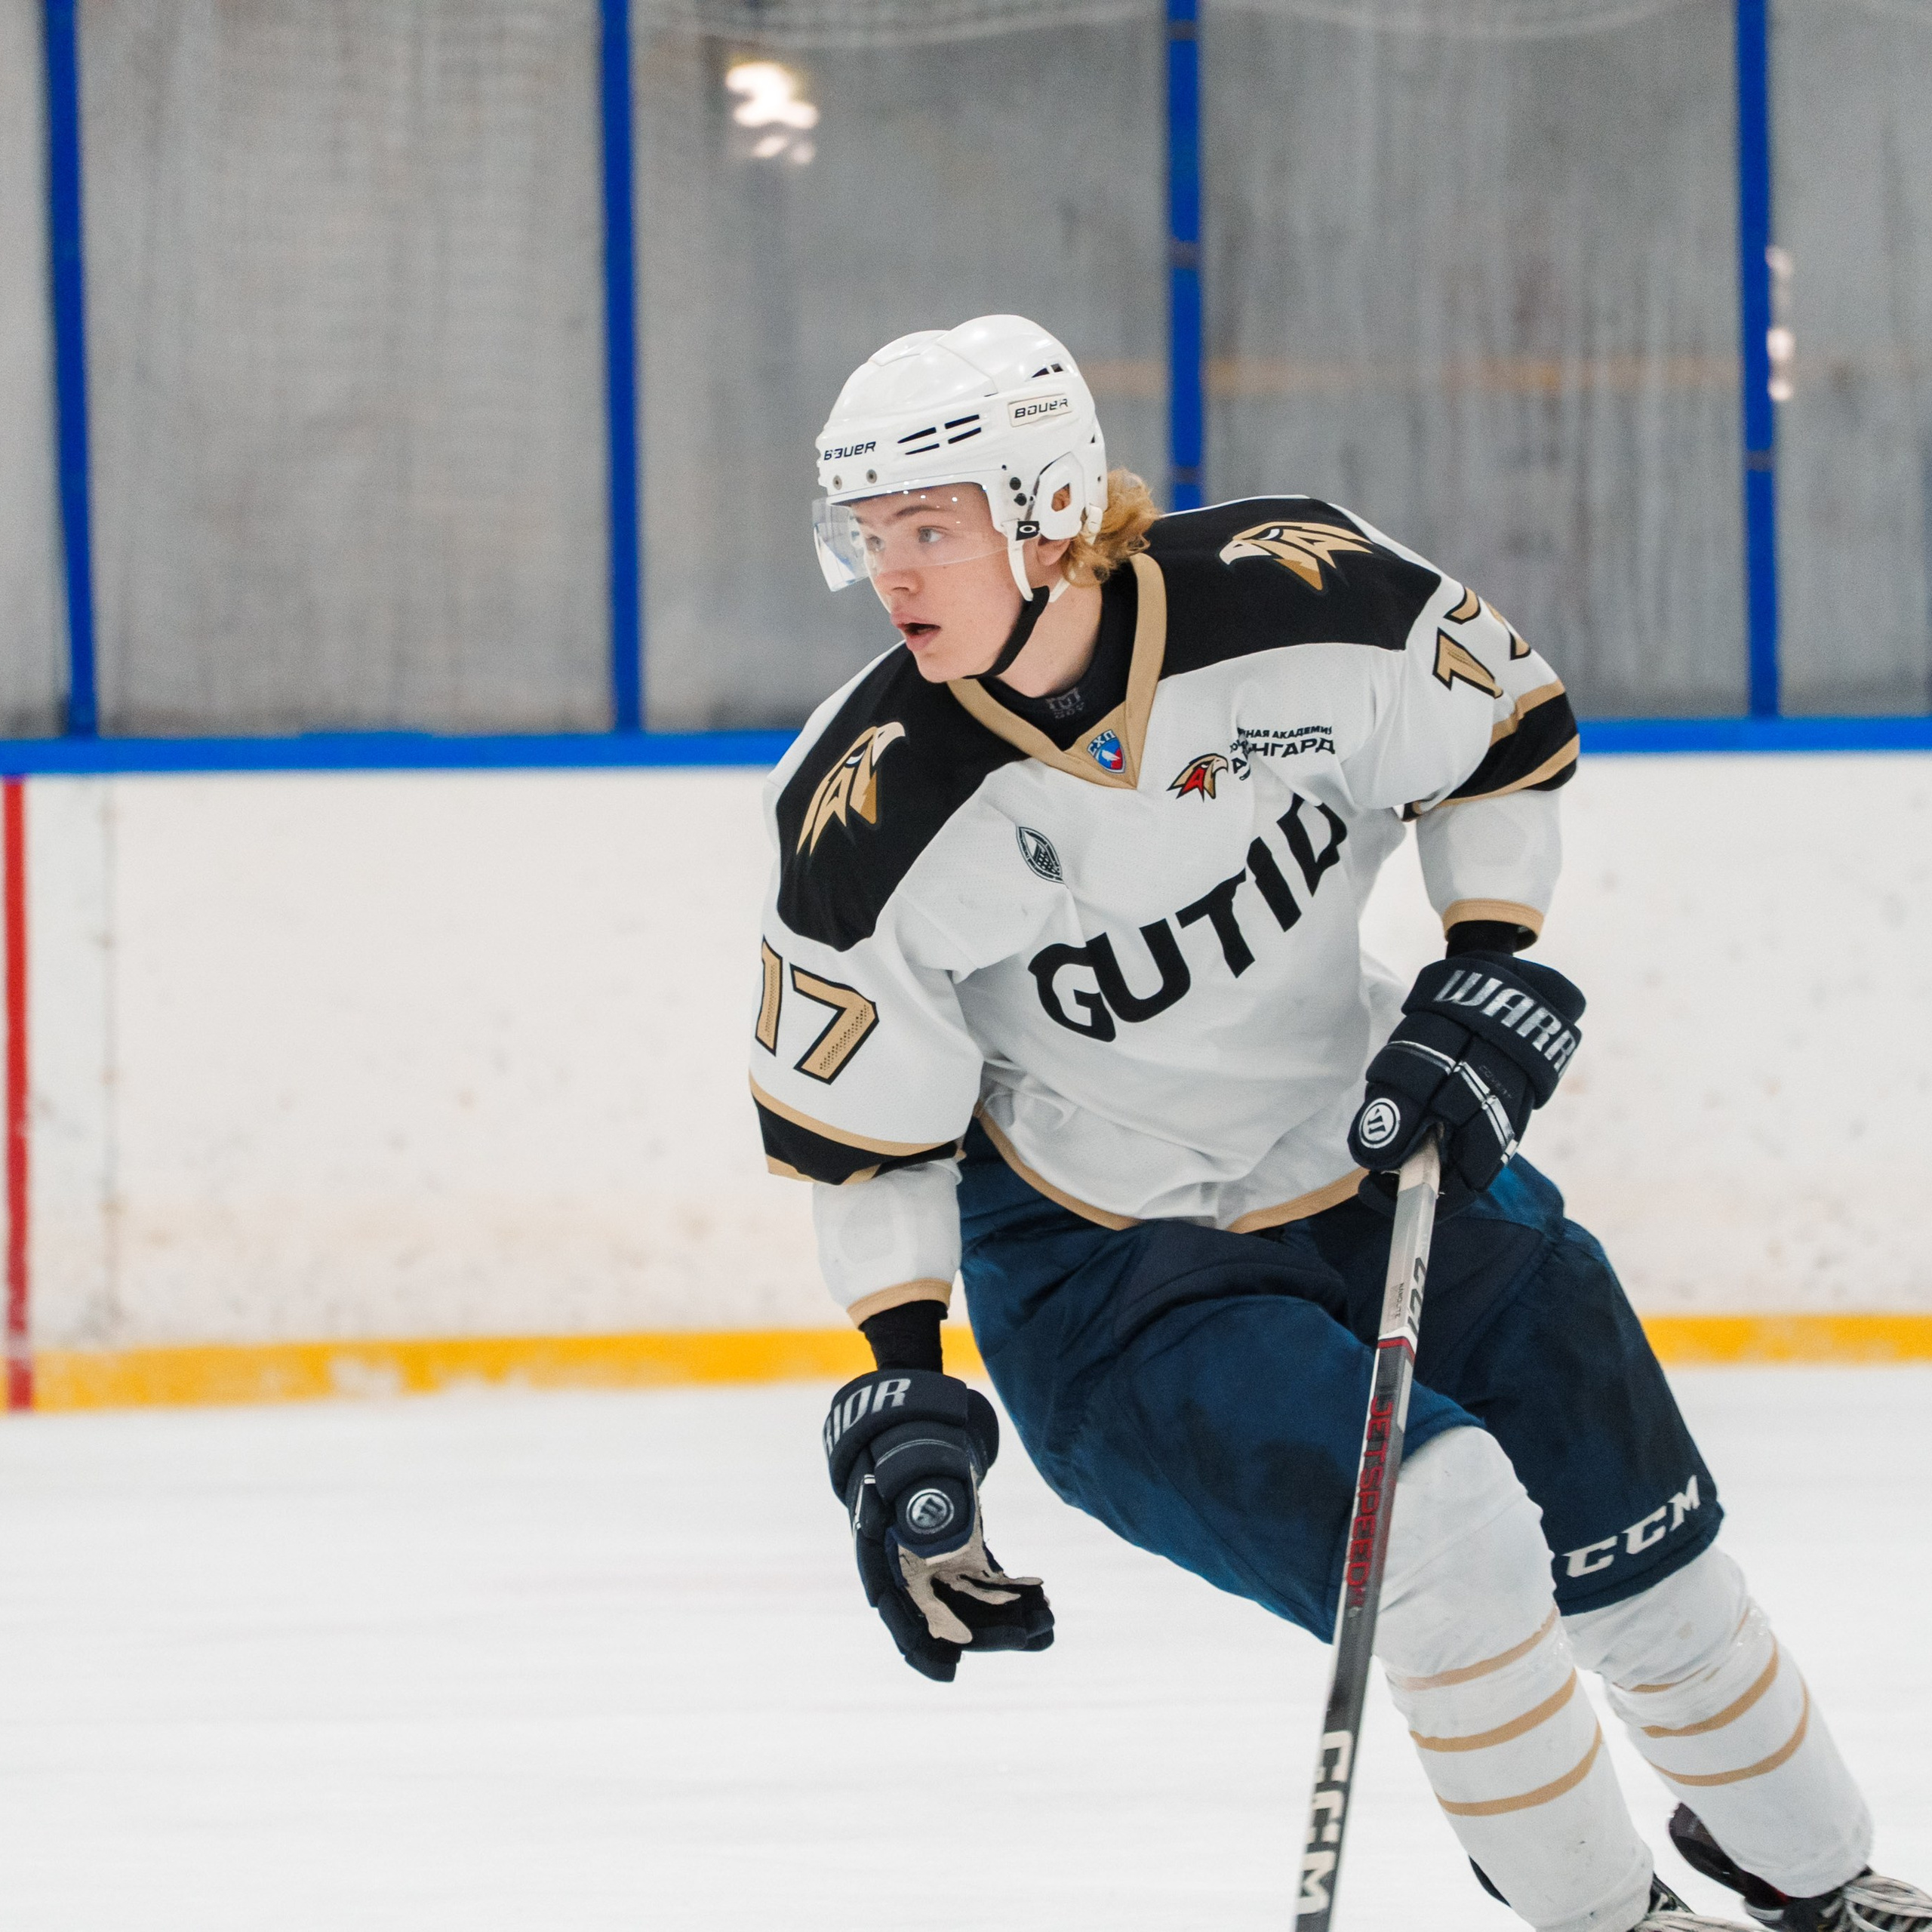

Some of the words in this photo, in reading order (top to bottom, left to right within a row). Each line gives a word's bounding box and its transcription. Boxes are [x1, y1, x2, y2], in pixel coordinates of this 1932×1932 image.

[823, 441, 877, 461] BAUER
[1014, 398, 1069, 419] BAUER
[1230, 737, 1336, 780] АНГАРД
[1027, 792, 1349, 1043] GUTID
[755, 933, 880, 1086] 17
[1432, 969, 1578, 1080] WARR
[1345, 1395, 1394, 1586] JETSPEED
[1561, 1474, 1701, 1578] CCM
[1295, 1730, 1352, 1915] CCM
